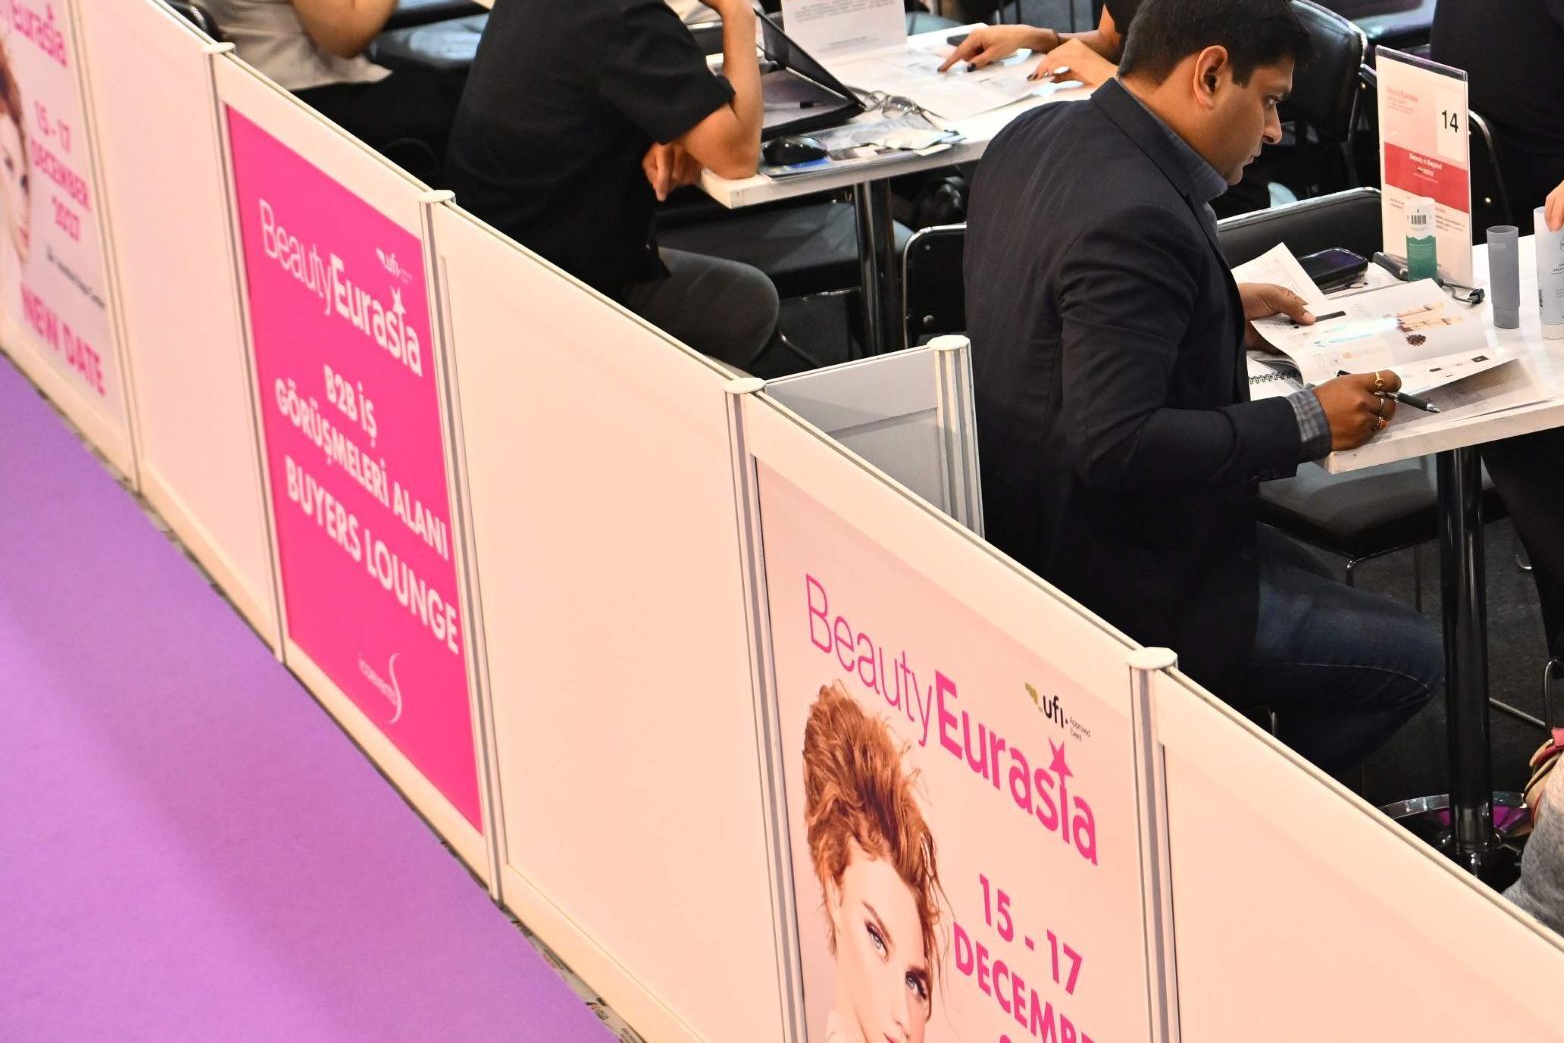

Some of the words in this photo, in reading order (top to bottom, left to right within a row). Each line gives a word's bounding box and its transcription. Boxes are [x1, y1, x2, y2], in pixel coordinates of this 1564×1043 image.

[30, 137, 91, 213] DECEMBER
[1441, 109, 1459, 133] 14
[20, 280, 60, 351] NEW
[63, 321, 106, 397] DATE
[259, 198, 423, 377] BeautyEurasia
[323, 363, 357, 422] B2B
[357, 381, 377, 448] İŞ
[275, 378, 390, 508] GÖRÜŞMELERİ
[393, 481, 449, 561] ALANI
[285, 454, 362, 563] BUYERS
[364, 528, 459, 655] LOUNGE
[805, 573, 1099, 866] BeautyEurasia
[1042, 694, 1064, 729] ufi
[953, 921, 1096, 1043] DECEMB
[979, 872, 1014, 943] 15
[1047, 928, 1083, 995] 17
